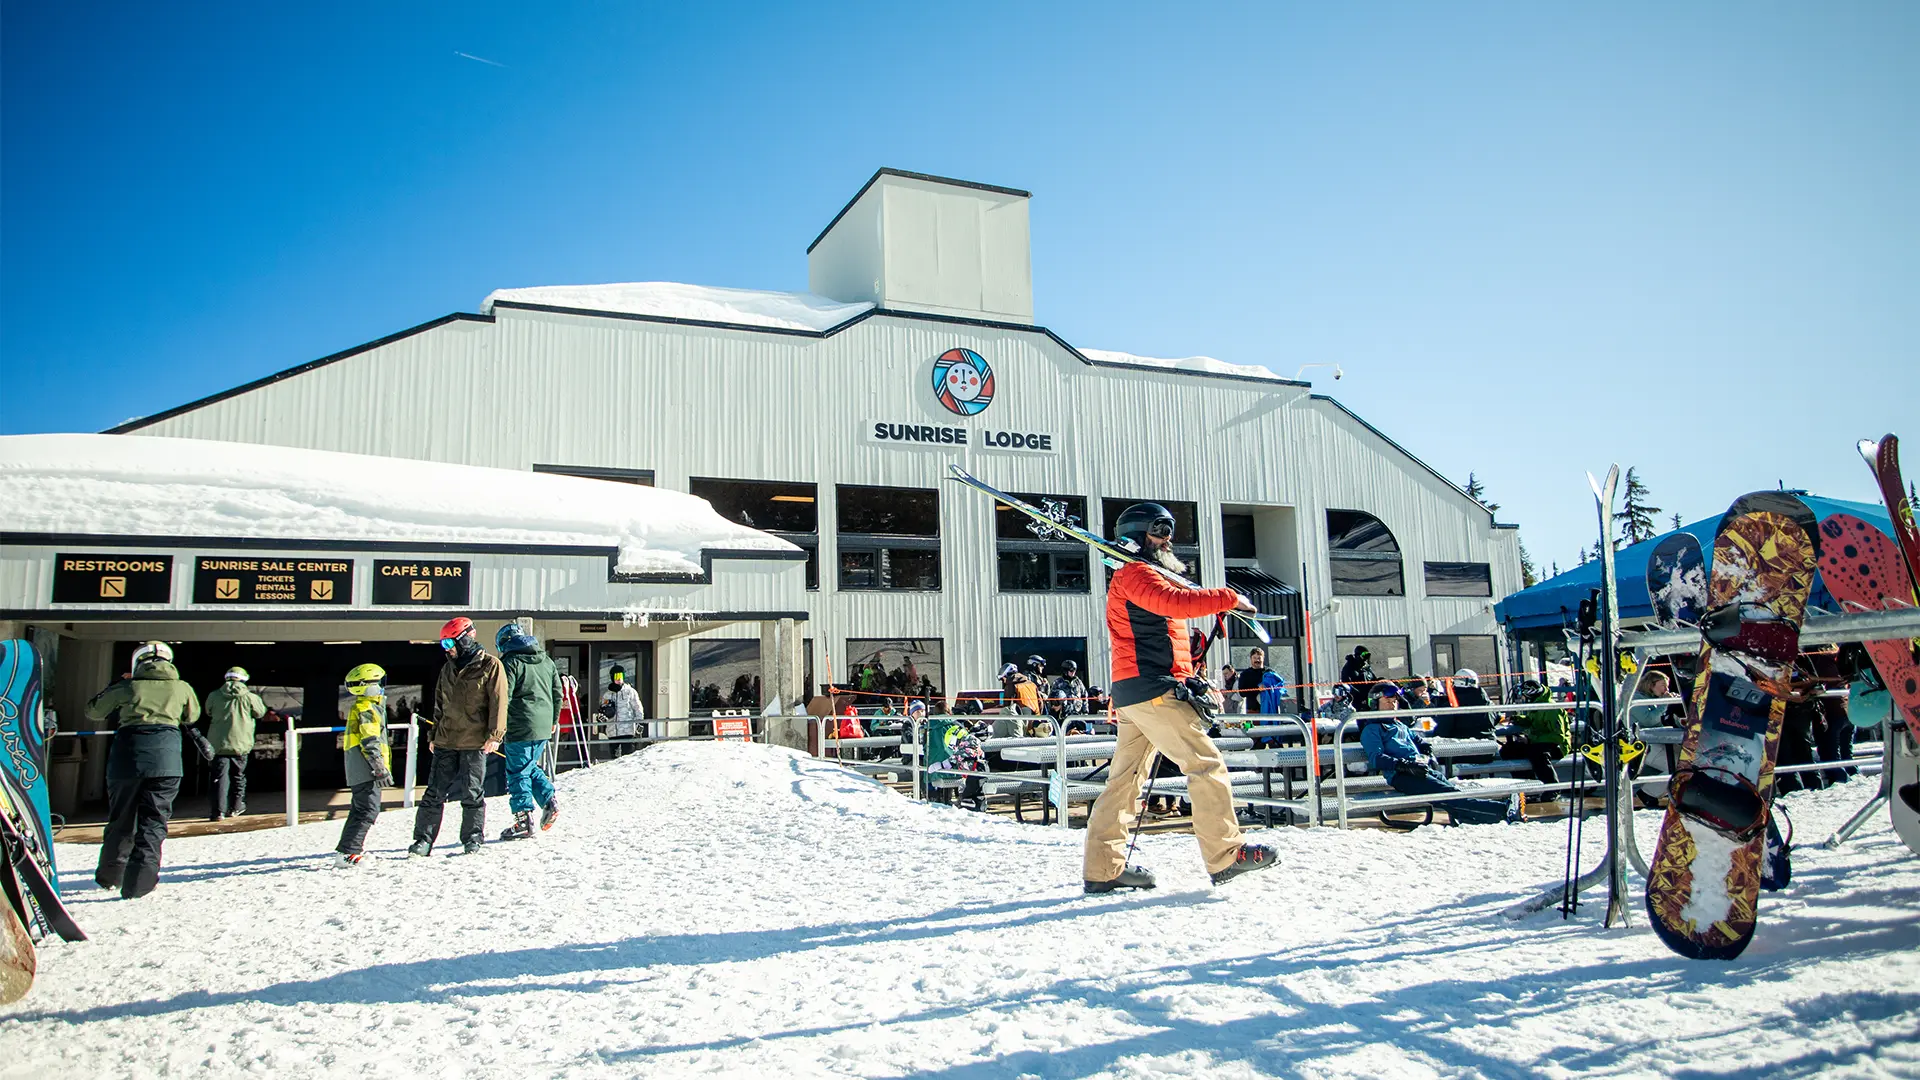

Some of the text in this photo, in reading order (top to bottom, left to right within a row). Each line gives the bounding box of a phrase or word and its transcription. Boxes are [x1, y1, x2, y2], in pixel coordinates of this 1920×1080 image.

[874, 422, 1052, 450] SUNRISE LODGE
[63, 560, 165, 572] RESTROOMS
[201, 560, 348, 572] SUNRISE SALE CENTER
[381, 564, 462, 577] CAFÉ & BAR
[258, 575, 295, 583] TICKETS
[255, 584, 296, 592] RENTALS
[254, 592, 296, 600] LESSONS
